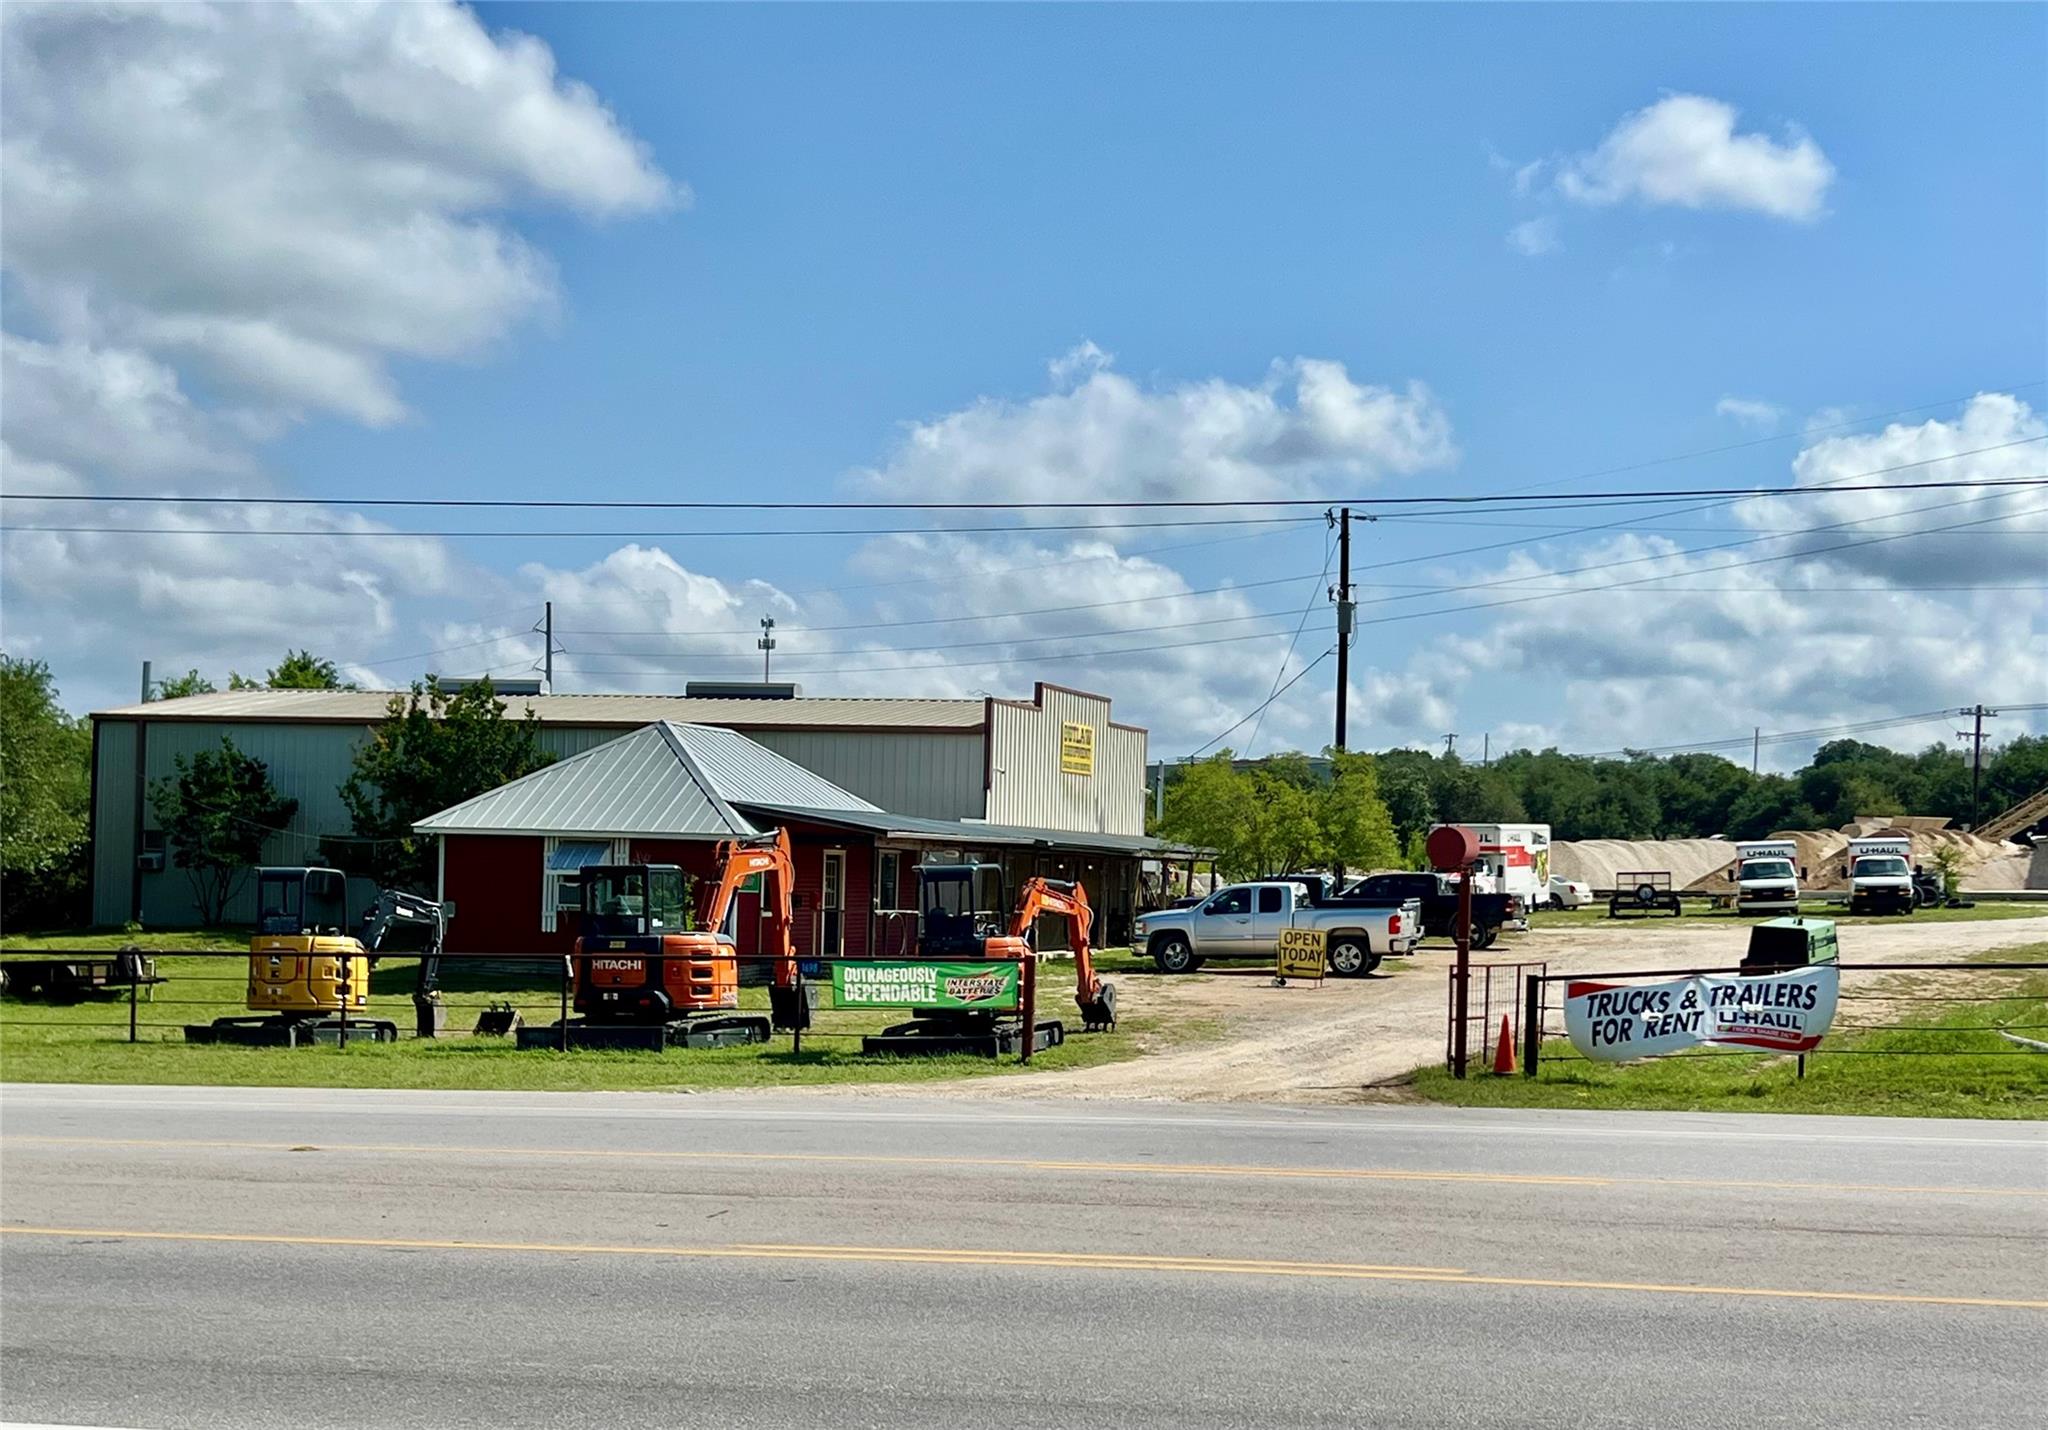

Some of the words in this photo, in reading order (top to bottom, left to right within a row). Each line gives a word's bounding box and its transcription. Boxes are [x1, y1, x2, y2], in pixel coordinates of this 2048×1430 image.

[1284, 931, 1321, 947] OPEN
[1281, 947, 1323, 962] TODAY
[592, 959, 642, 970] HITACHI
[844, 967, 938, 983] OUTRAGEOUSLY
[946, 978, 1005, 986] INTERSTATE
[844, 984, 937, 1002] DEPENDABLE
[948, 987, 1001, 995] BATTERIES
[1587, 991, 1671, 1018] TRUCKS
[1680, 989, 1698, 1010] &
[1710, 983, 1818, 1010] TRAILERS
[1719, 1011, 1802, 1030] U-HAUL
[1592, 1018, 1633, 1047] FOR
[1643, 1011, 1704, 1039] RENT
